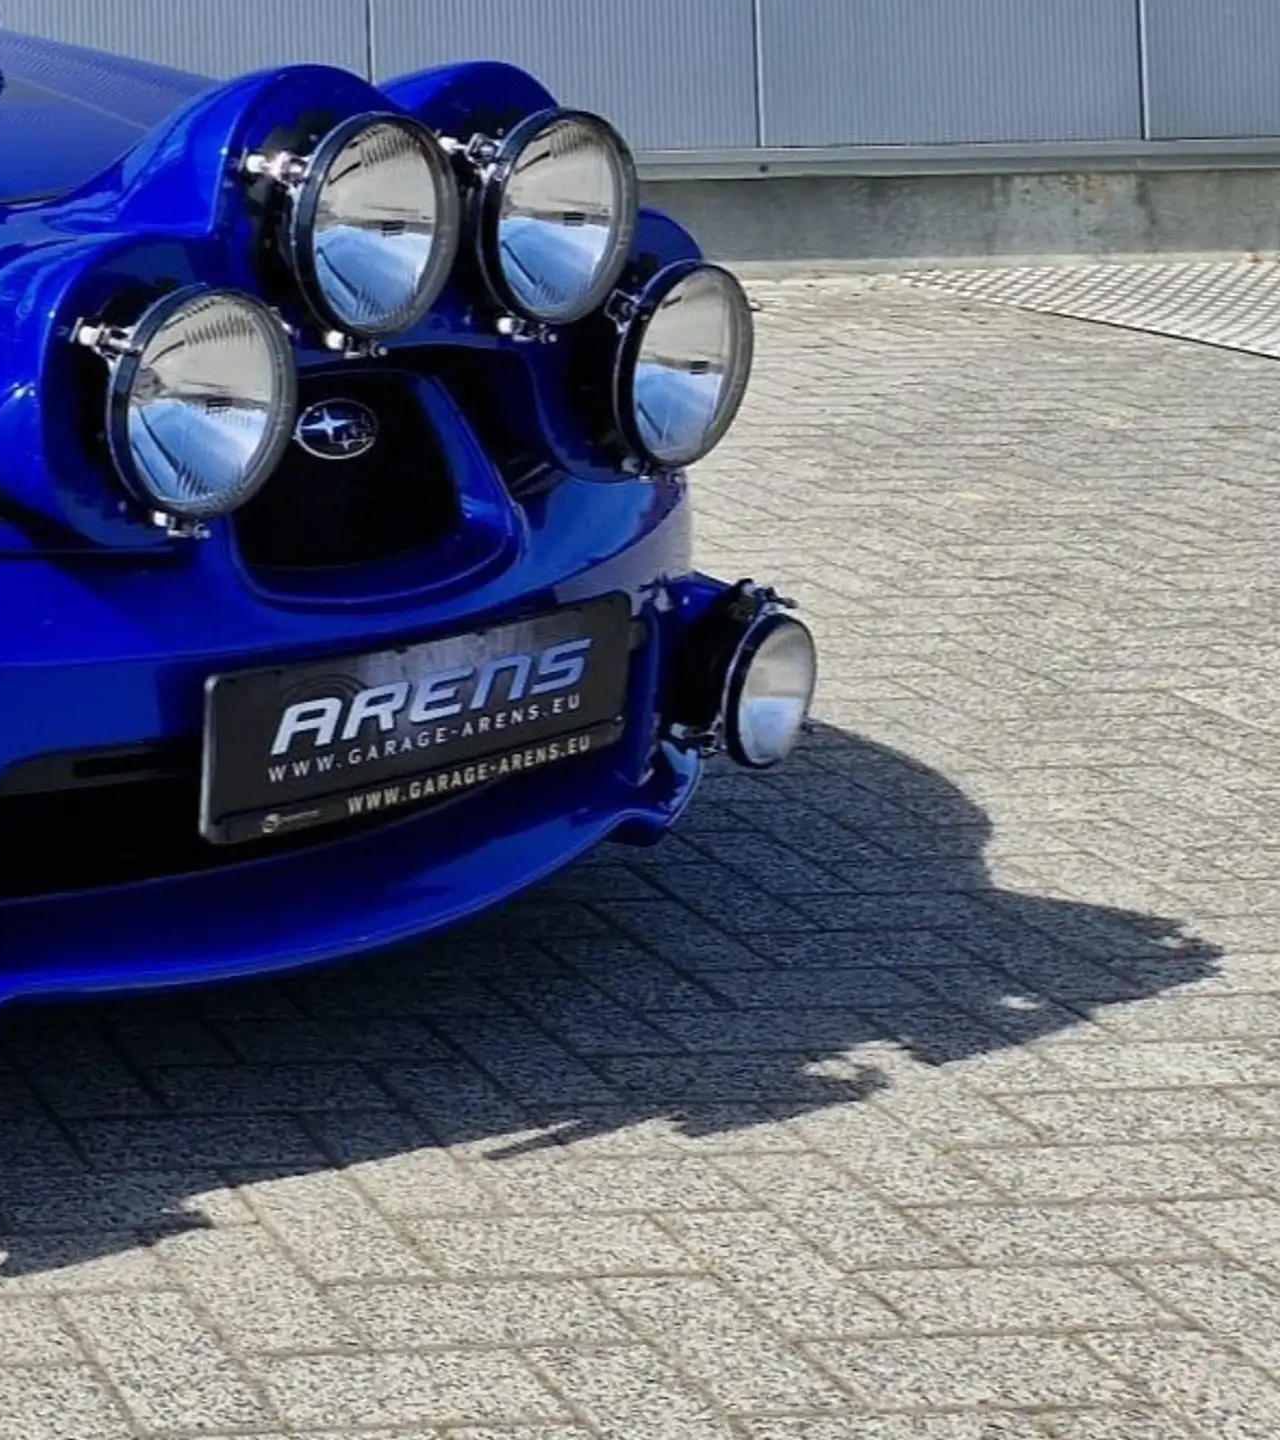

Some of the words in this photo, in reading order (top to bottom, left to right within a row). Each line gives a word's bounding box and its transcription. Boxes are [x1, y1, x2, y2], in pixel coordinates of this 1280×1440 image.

[267, 692, 581, 784] WWW.GARAGE-ARENS.EU
[270, 638, 592, 757] ARENS
[347, 734, 592, 816] WWW.GARAGE-ARENS.EU
